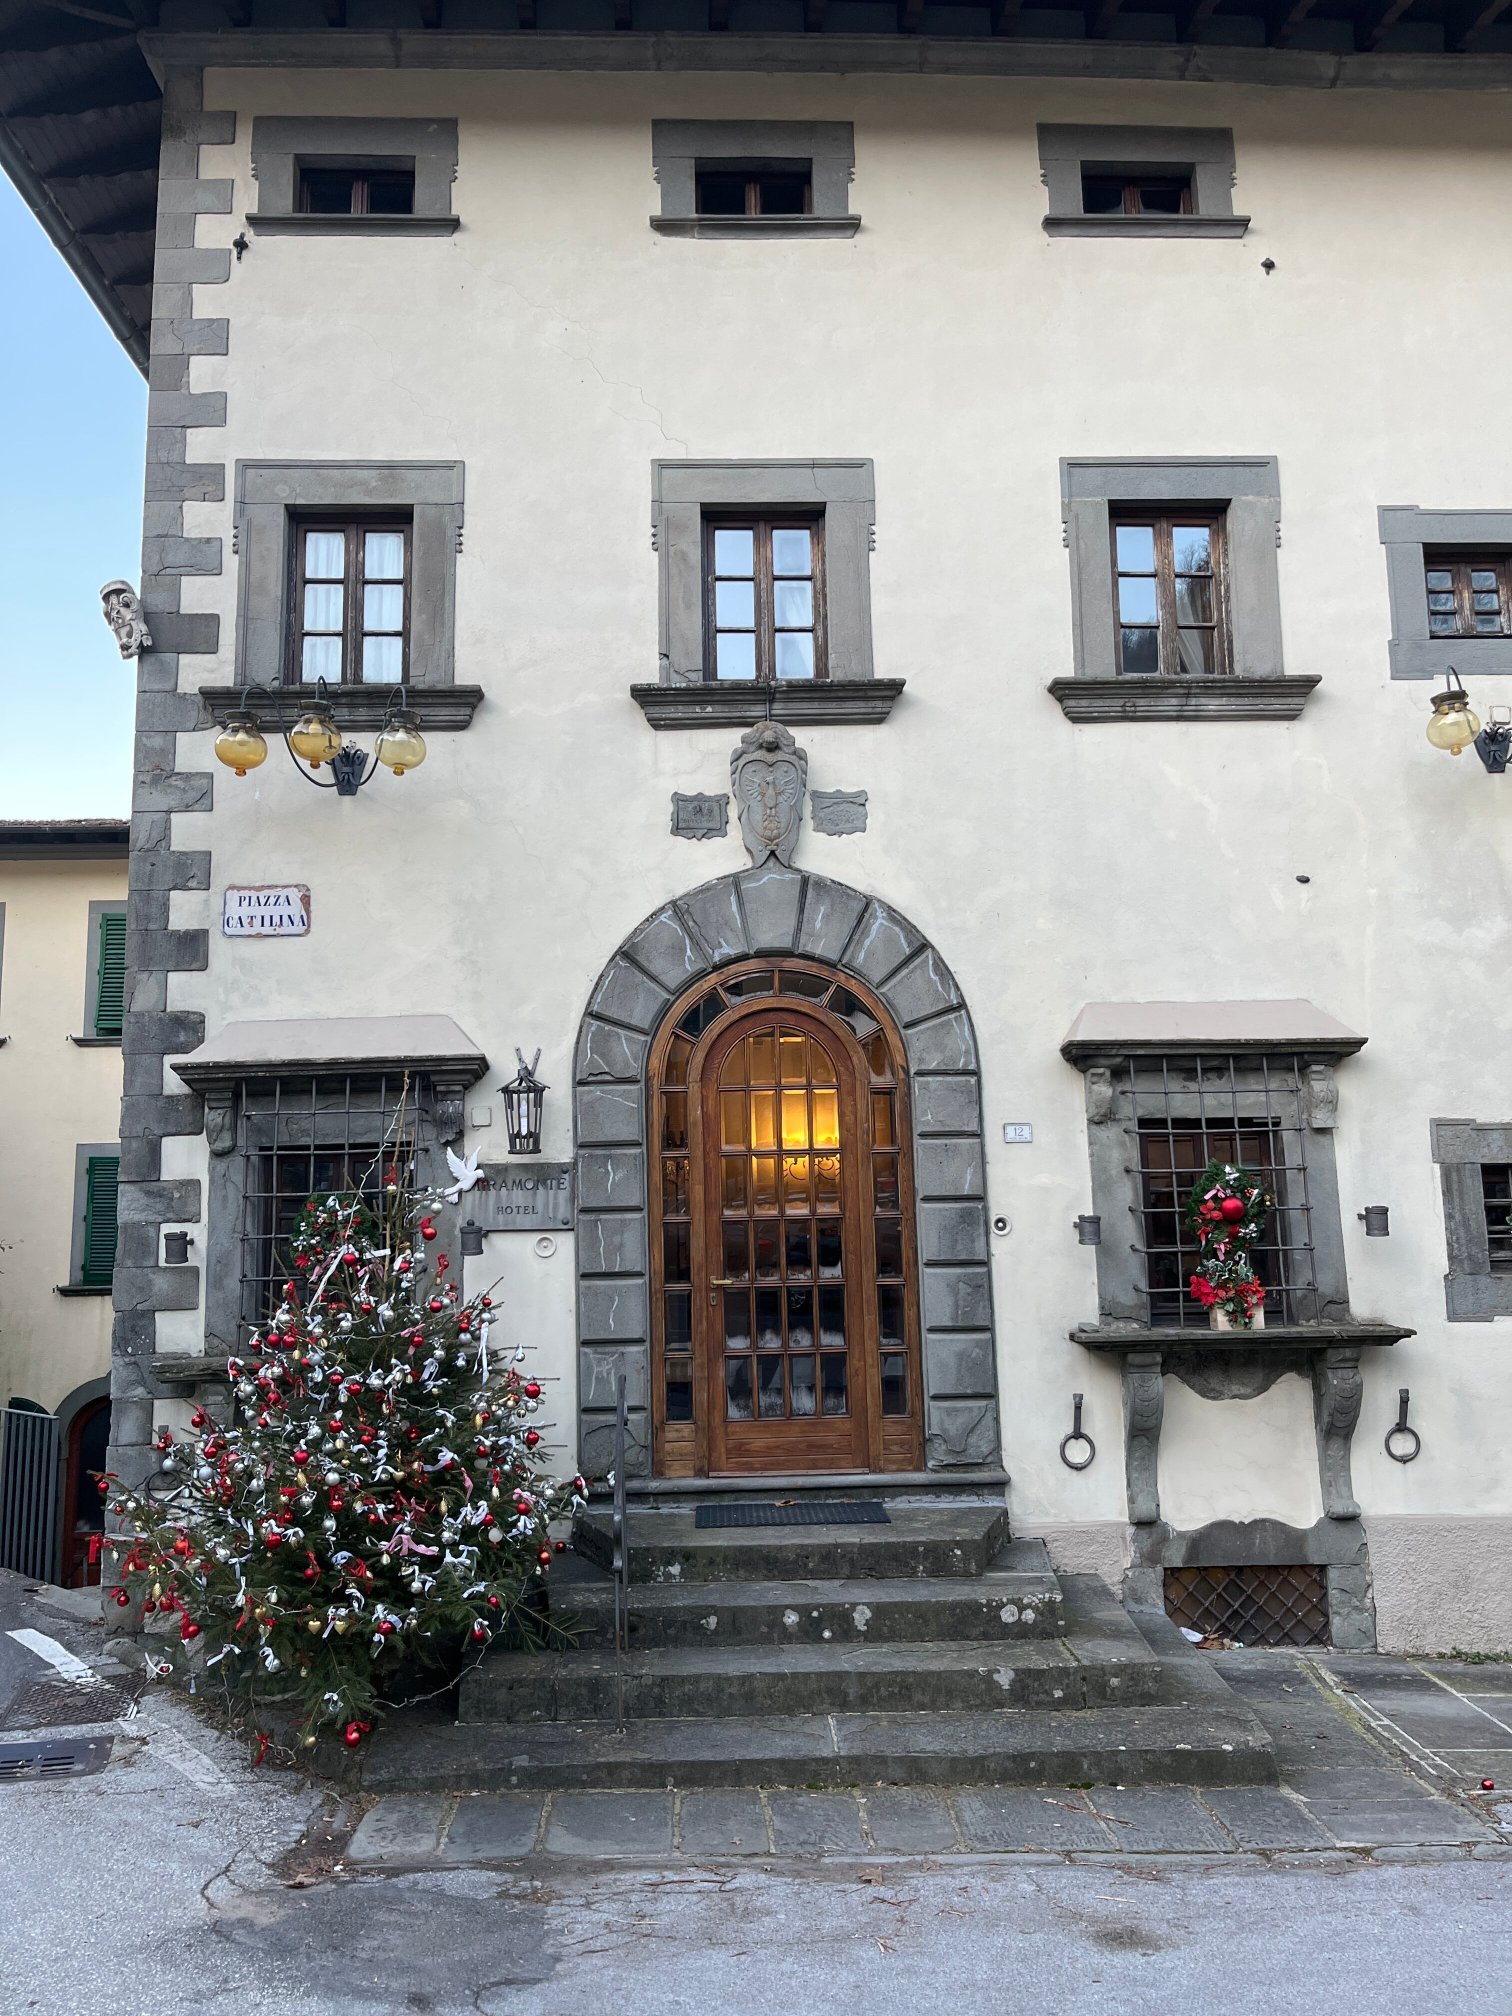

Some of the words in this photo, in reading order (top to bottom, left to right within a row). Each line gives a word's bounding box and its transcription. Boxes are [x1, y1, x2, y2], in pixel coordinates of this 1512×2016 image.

[238, 895, 291, 907] PIAZZA
[226, 914, 306, 928] CATILINA
[1014, 1126, 1024, 1137] 12
[475, 1177, 568, 1192] RAMONTE
[496, 1205, 539, 1215] HOTEL
